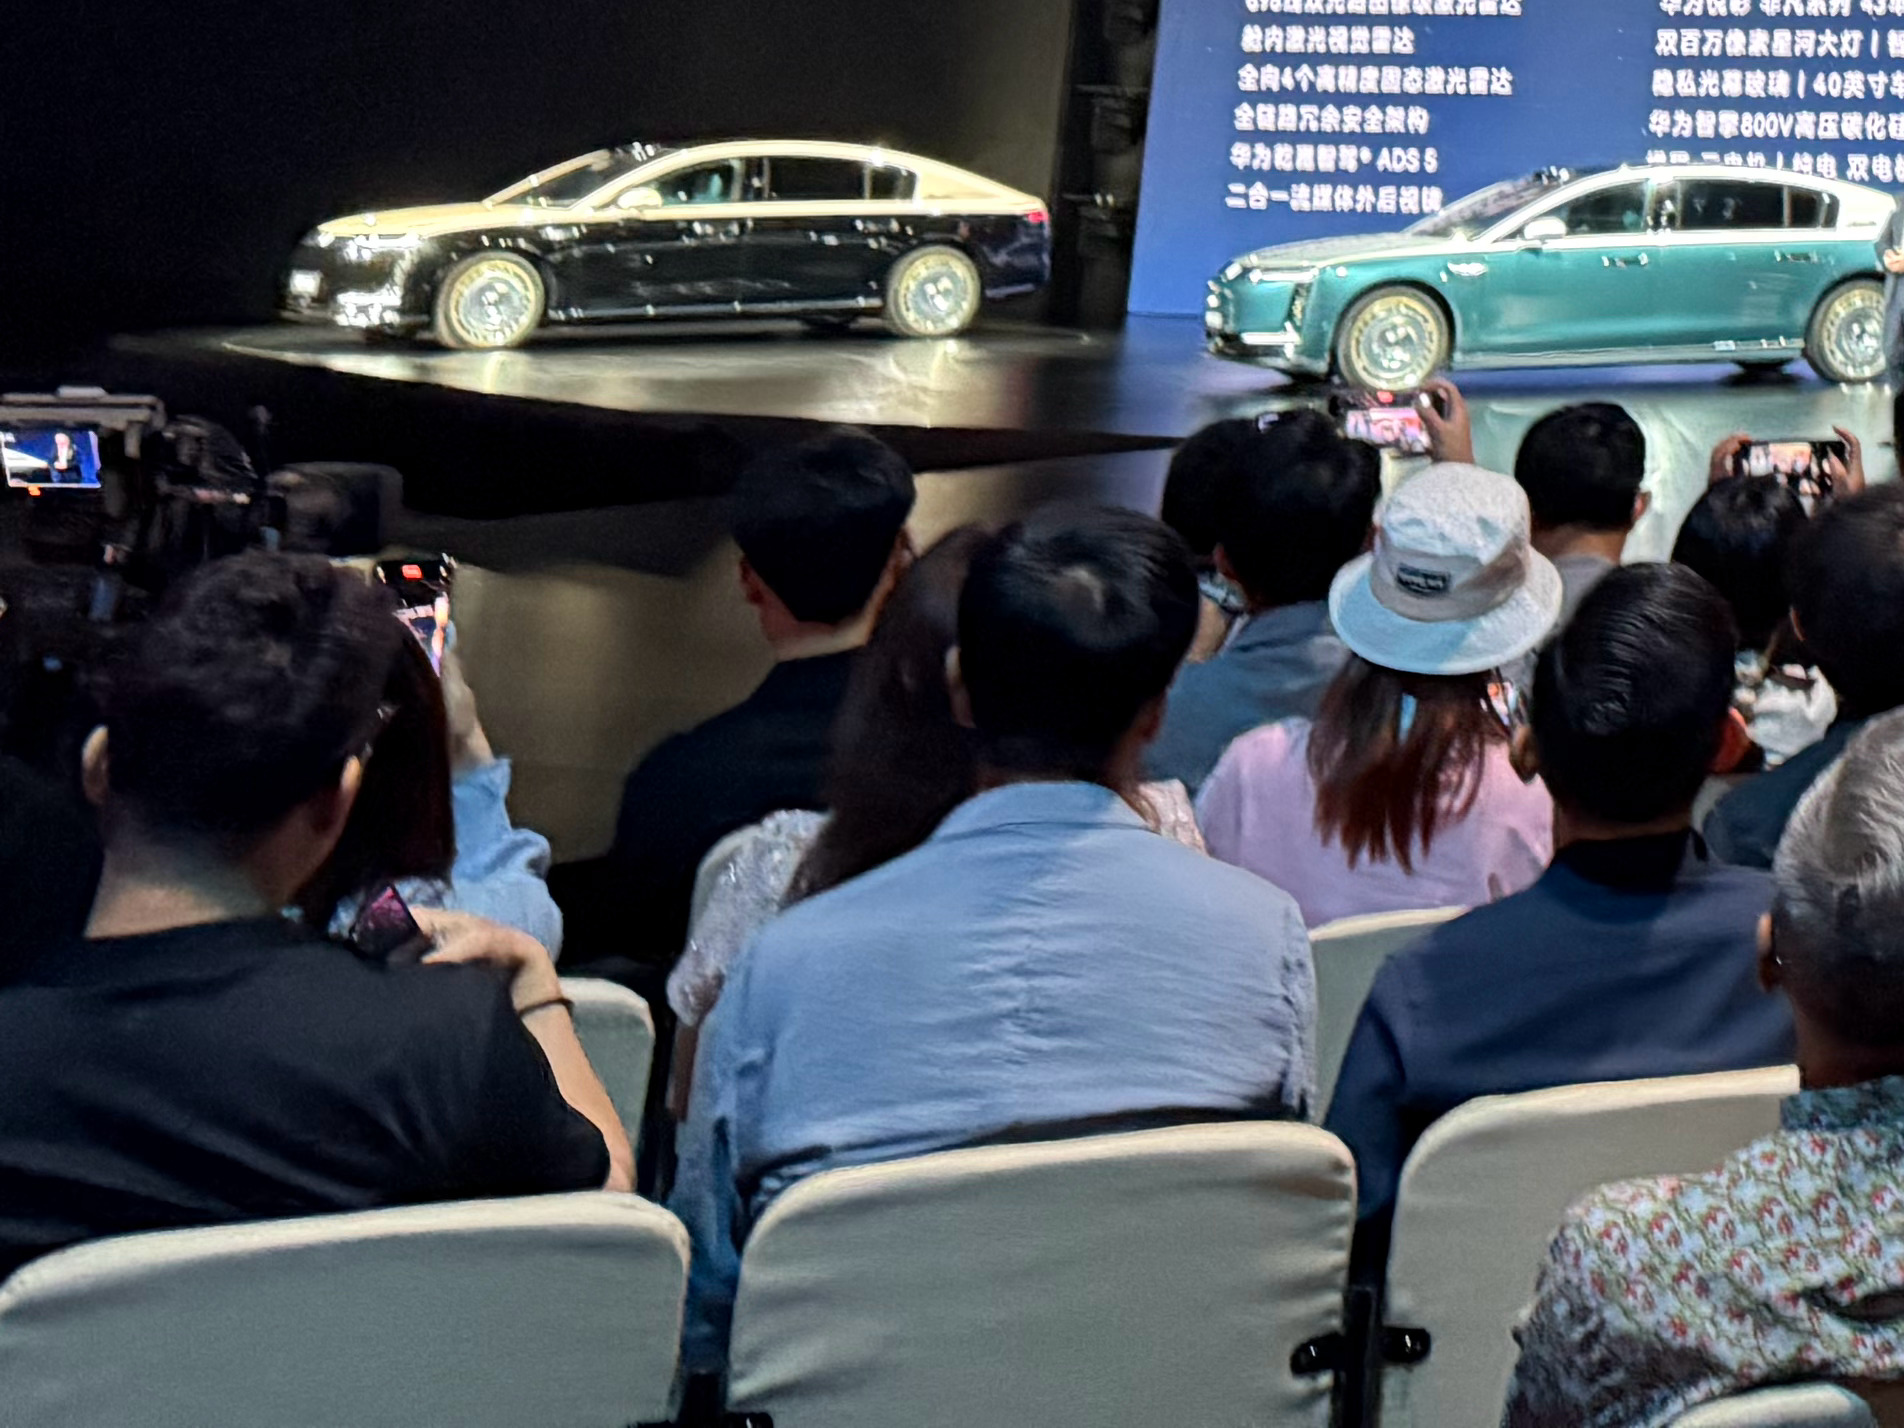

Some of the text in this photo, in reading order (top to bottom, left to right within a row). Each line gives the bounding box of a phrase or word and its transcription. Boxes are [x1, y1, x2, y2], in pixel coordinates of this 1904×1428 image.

[1655, 28, 1864, 58] 双百万像素星河大灯
[1651, 68, 1791, 99] 隐私光幕玻璃
[1376, 147, 1420, 173] ADS
